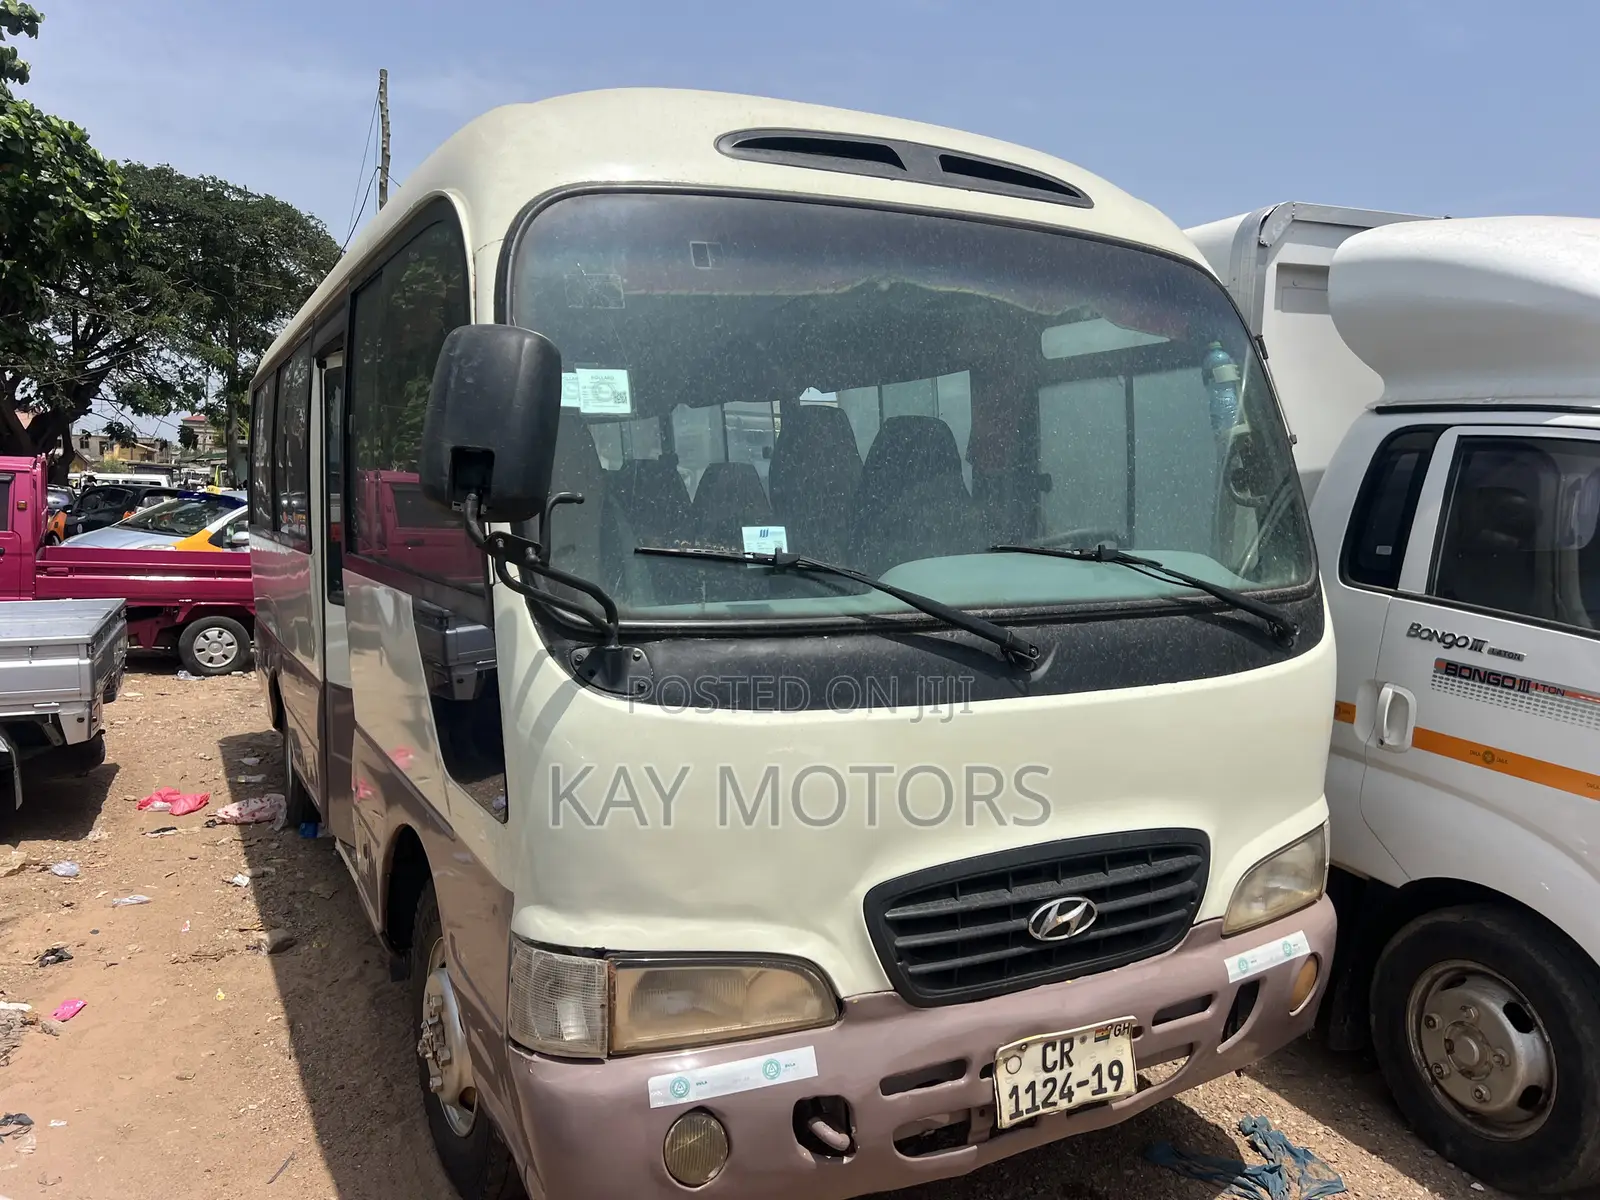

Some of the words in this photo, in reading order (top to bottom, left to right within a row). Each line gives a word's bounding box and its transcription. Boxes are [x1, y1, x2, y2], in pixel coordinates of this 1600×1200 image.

[1445, 662, 1516, 689] BONGO
[1518, 679, 1532, 694] III
[1113, 1022, 1131, 1038] GH
[1042, 1038, 1075, 1073] CR
[1008, 1059, 1124, 1121] 1124-19
